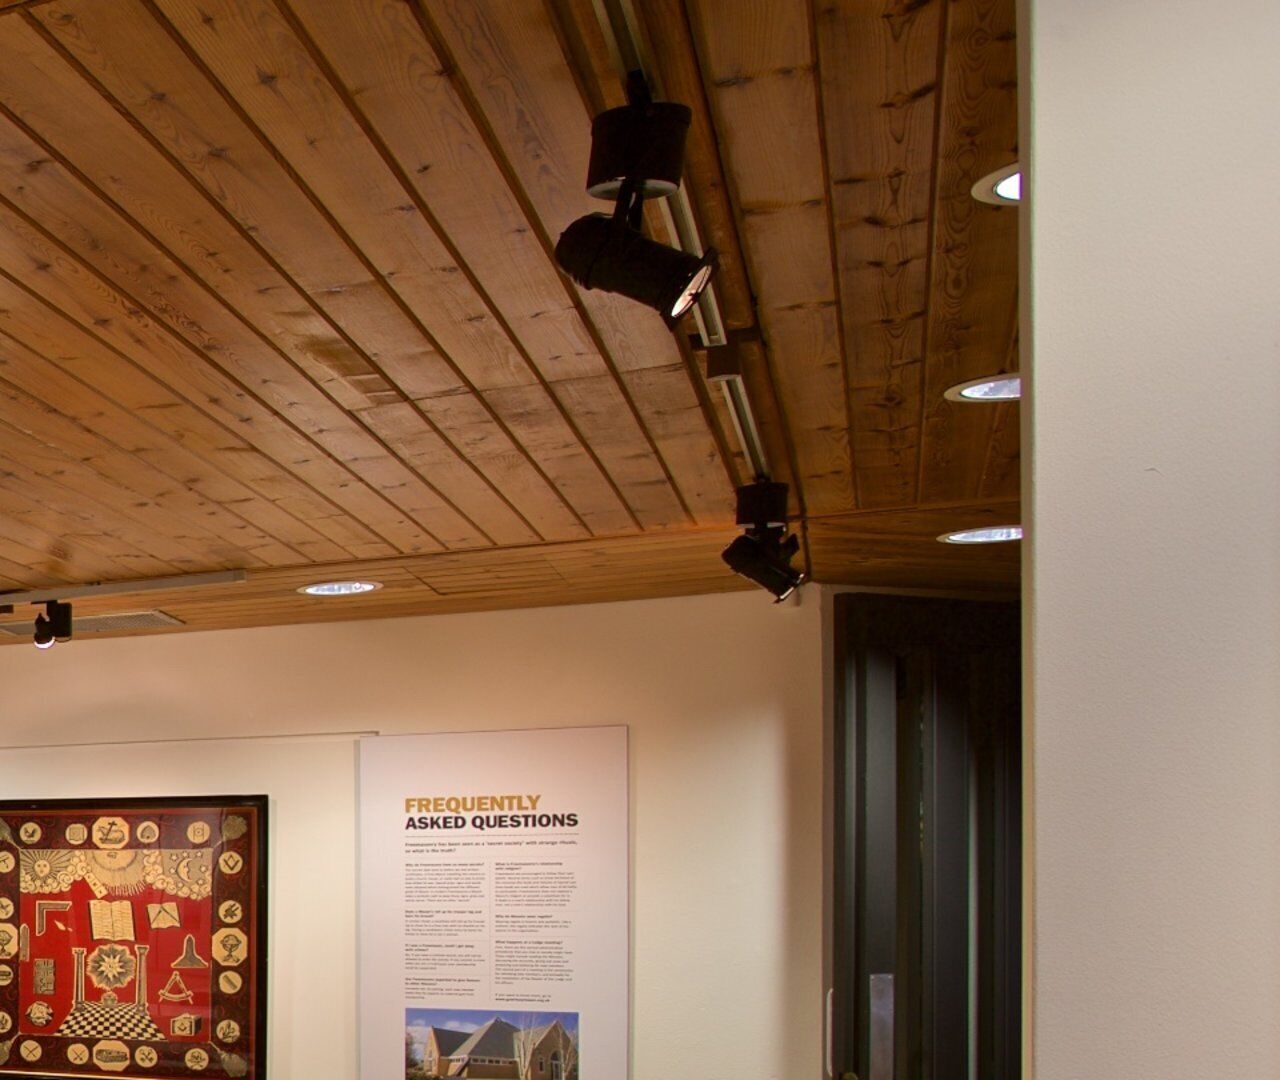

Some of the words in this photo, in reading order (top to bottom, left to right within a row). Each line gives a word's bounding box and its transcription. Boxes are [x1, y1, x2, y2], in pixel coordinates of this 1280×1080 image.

[405, 794, 541, 814] FREQUENTLY
[405, 816, 467, 831] ASKED
[471, 813, 579, 831] QUESTIONS
